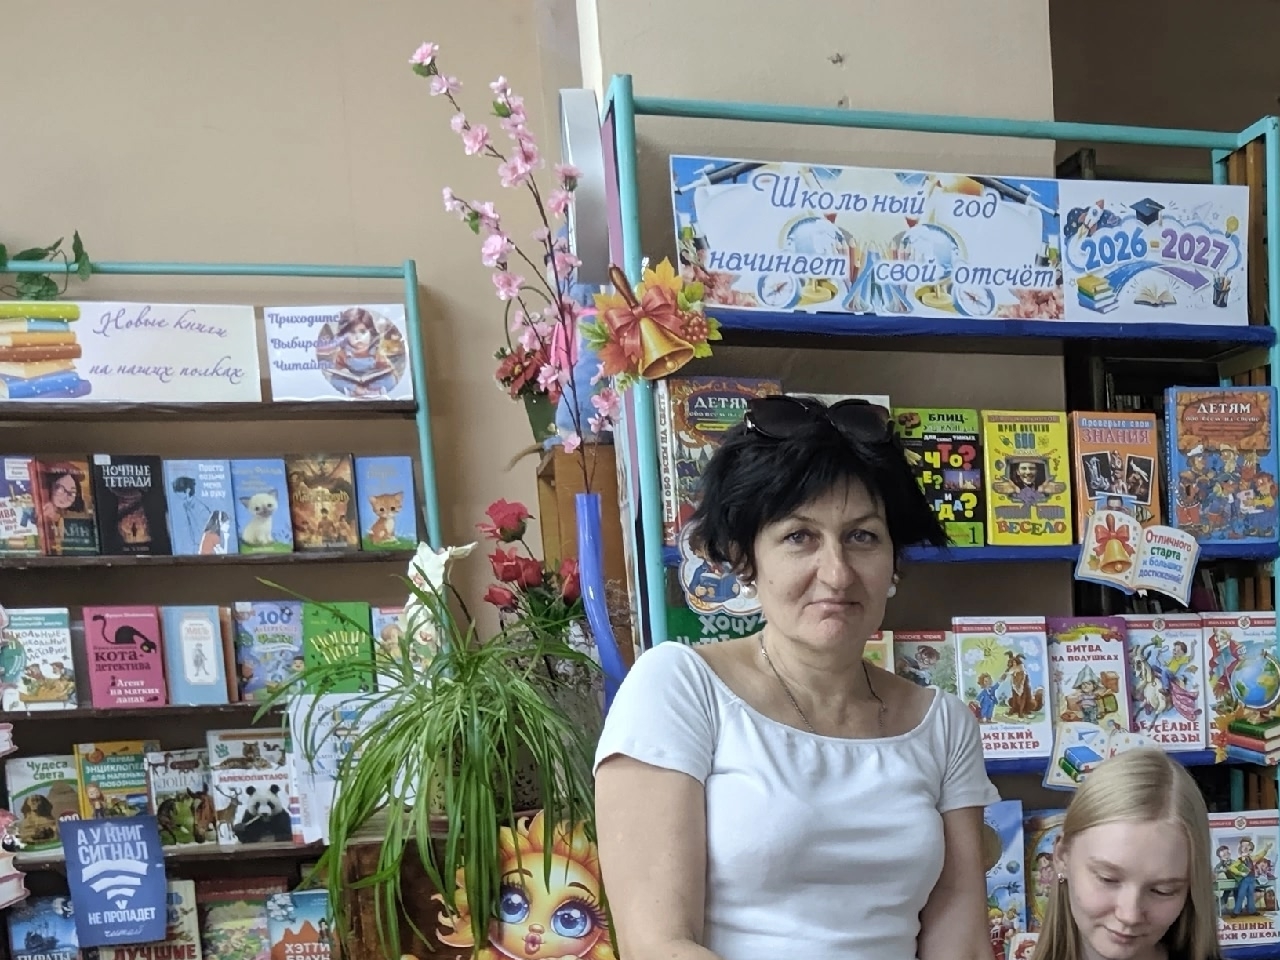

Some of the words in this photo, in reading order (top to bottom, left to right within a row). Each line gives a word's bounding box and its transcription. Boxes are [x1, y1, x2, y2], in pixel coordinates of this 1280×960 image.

[751, 172, 925, 216] Школьный
[952, 199, 998, 220] год
[708, 250, 847, 277] начинает
[874, 259, 938, 284] свой
[953, 264, 1055, 288] отсчёт
[93, 306, 169, 337] Новые
[173, 309, 229, 338] книги
[88, 363, 111, 377] на
[117, 364, 174, 383] наших
[179, 356, 247, 384] полках
[1197, 402, 1251, 414] ДЕТЯМ
[929, 413, 969, 424] БЛИЦ-
[1082, 428, 1151, 444] ЗНАНИЯ
[102, 464, 150, 476] НОЧНЫЕ
[198, 463, 225, 472] Просто
[104, 476, 151, 488] ТЕТРАДИ
[929, 492, 978, 520] ГДА?
[996, 521, 1067, 536] ВЕСЕЛО
[968, 526, 980, 545] 1
[258, 611, 293, 625] 100
[698, 615, 759, 636] ХОЧУ
[1066, 645, 1102, 653] БИТВА
[1068, 654, 1119, 663] ПОДУШКАХ
[95, 662, 151, 672] детектива
[982, 728, 1034, 741] МЯГКИЙ
[1148, 734, 1201, 744] СКАЗЫ
[26, 760, 68, 772] Чудеса
[86, 764, 146, 774] ЭНЦИКЛОПЕД
[33, 771, 65, 781] света
[219, 774, 288, 783] МЛЕКОПИТАЮ
[77, 829, 87, 845] А
[90, 827, 101, 842] У
[106, 825, 144, 842] КНИГ
[78, 841, 149, 865] СИГНАЛ
[88, 912, 102, 925] НЕ
[104, 907, 156, 924] ПРОПАДЕТ
[1219, 921, 1275, 931] МЕШНЫЕ
[285, 942, 331, 955] ХЭТТИ
